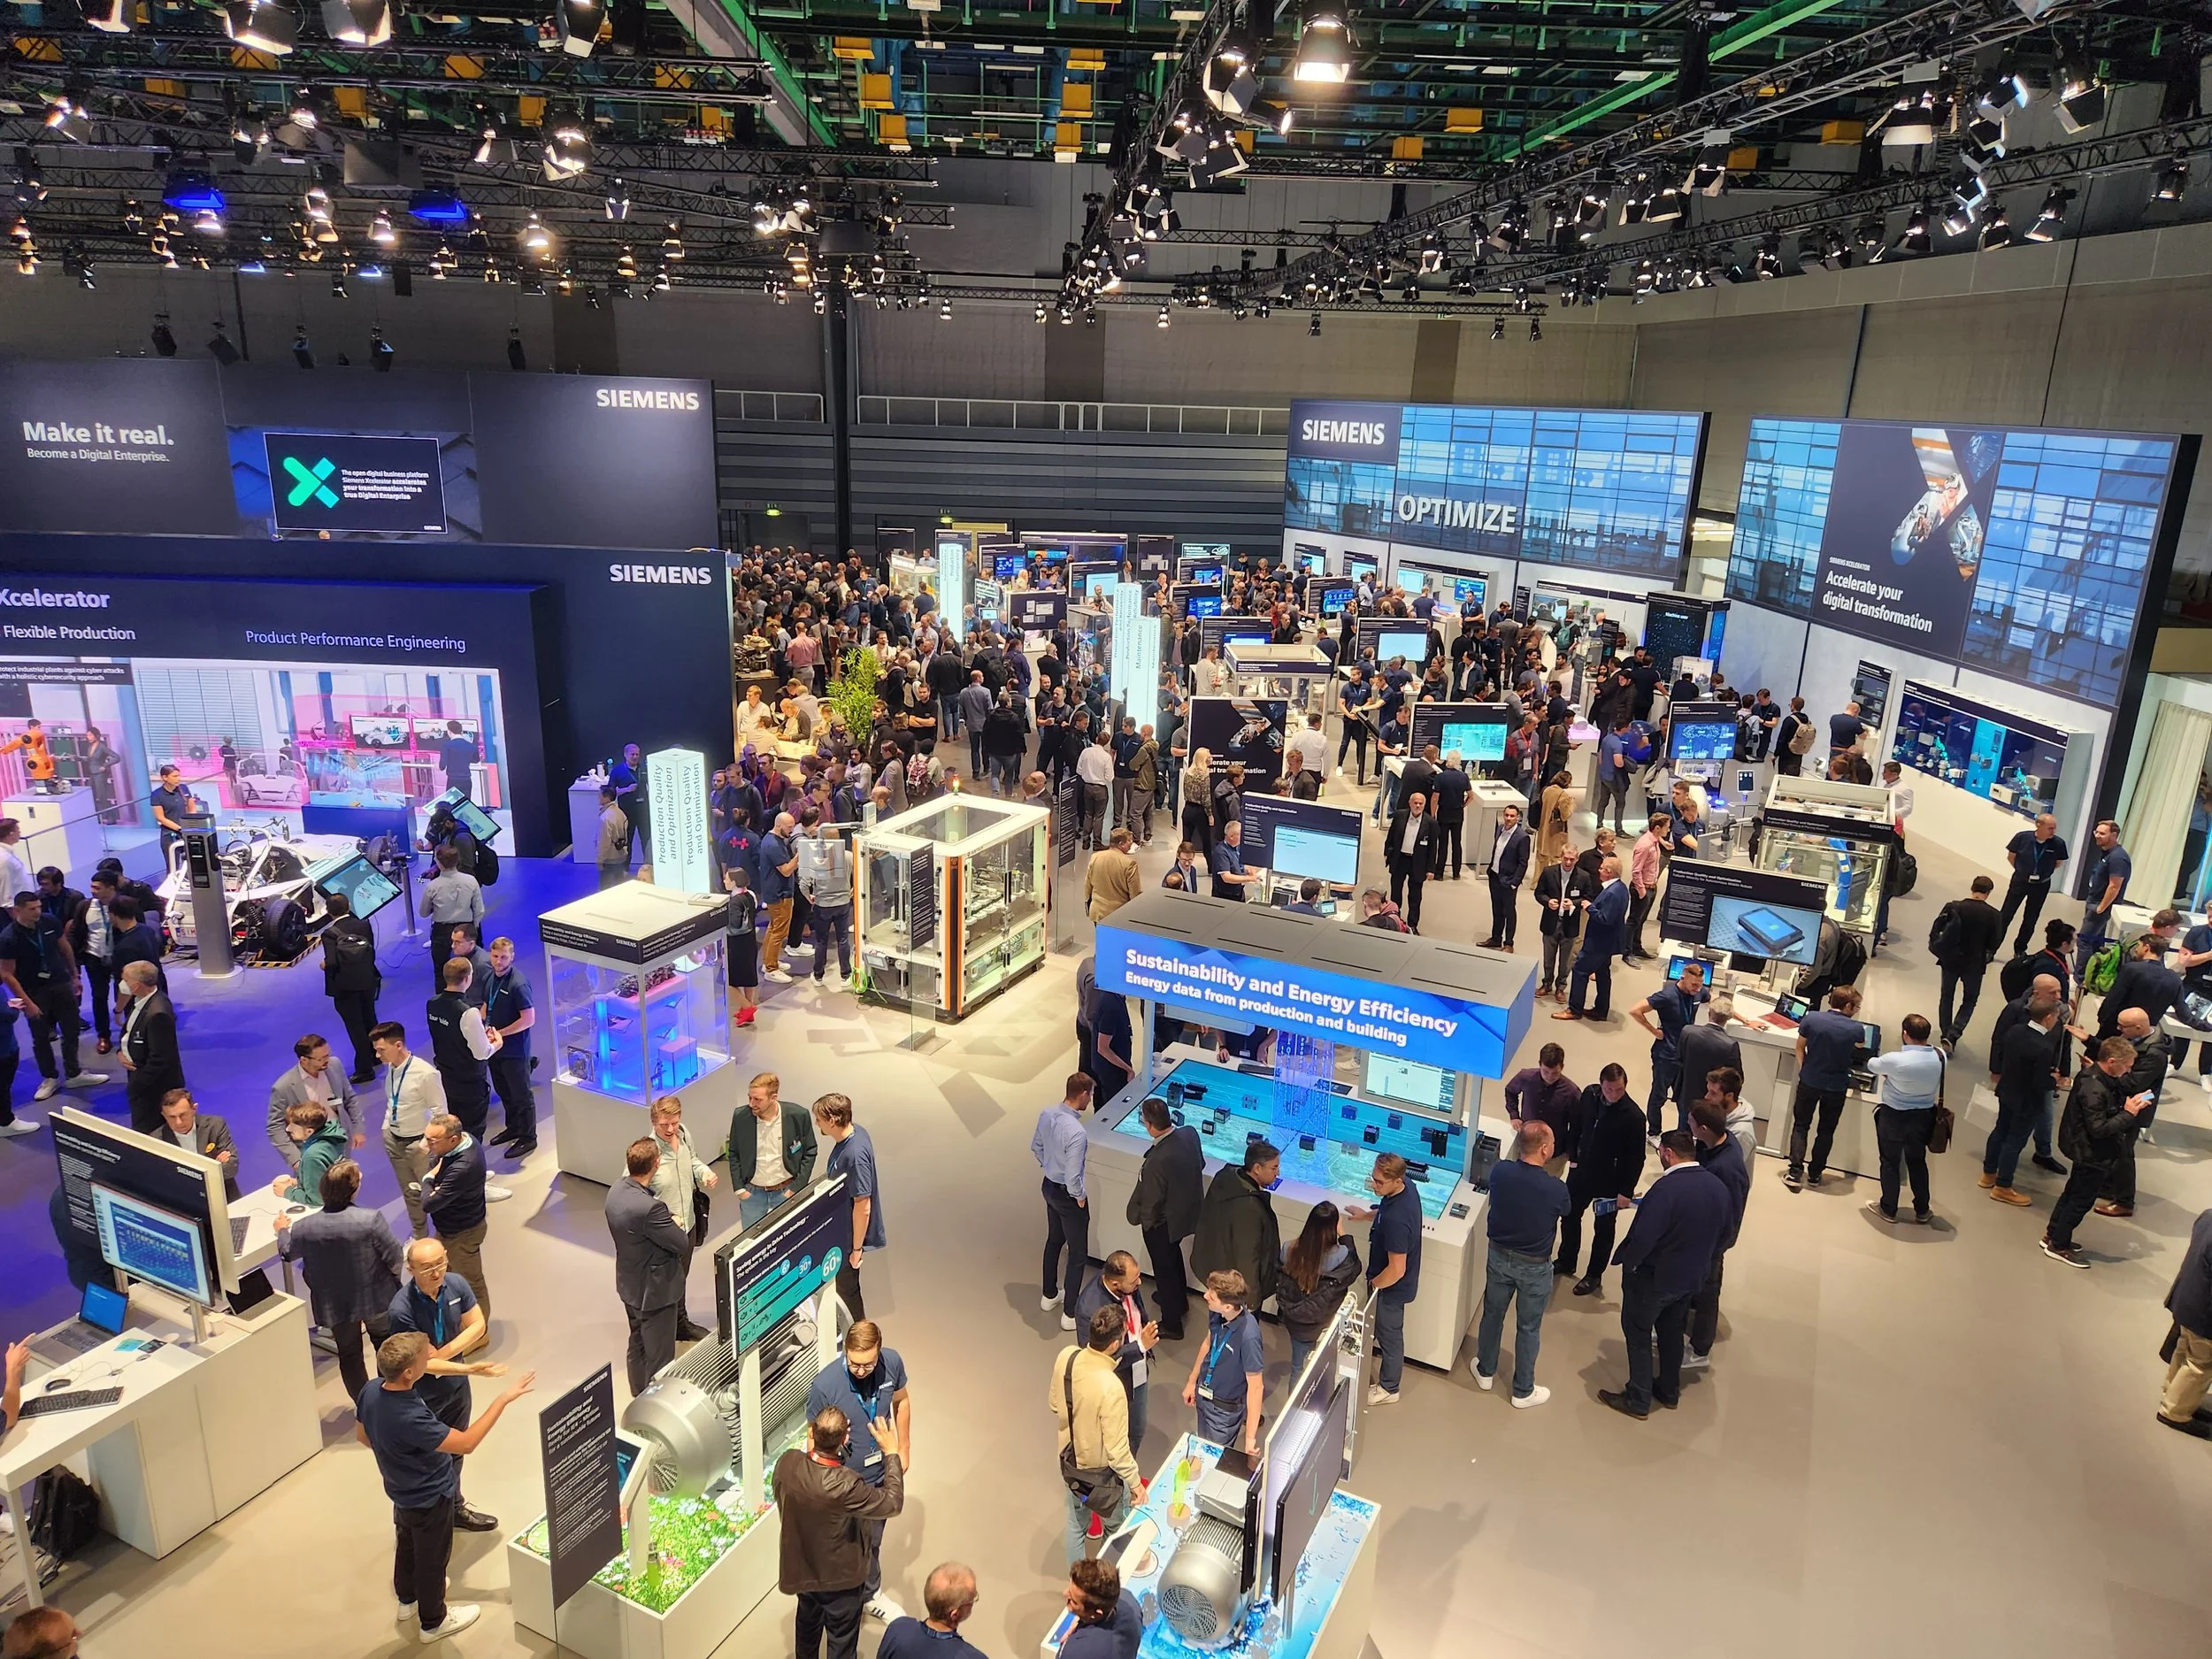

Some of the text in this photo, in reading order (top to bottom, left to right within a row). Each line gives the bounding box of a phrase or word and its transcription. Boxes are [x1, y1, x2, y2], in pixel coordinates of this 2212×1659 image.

[596, 389, 699, 411] SIEMENS
[22, 421, 175, 446] Make it real.
[1302, 419, 1385, 445] SIEMENS
[27, 448, 170, 463] Become a Digital Enterprise.
[1398, 495, 1517, 534] OPTIMIZE
[1829, 557, 1847, 566] SIEMENS
[609, 564, 712, 585] SIEMENS
[1825, 570, 1903, 601] Accelerate your
[0, 588, 111, 608] Xcelerator
[1823, 590, 1932, 633] digital transformation
[4, 626, 136, 640] Flexible Production
[245, 630, 466, 653] Product Performance Engineering
[682, 765, 691, 804] Quality
[666, 767, 676, 836] Optimization
[693, 763, 703, 832] Optimization
[654, 764, 666, 864] Production Quality
[1801, 881, 1825, 890] SIEMENS
[616, 939, 637, 948] SIEMENS
[1125, 949, 1458, 1038] Sustainability and Energy Efficiency
[1125, 971, 1408, 1048] Energy data from production and building
[177, 1166, 203, 1181] SIEMENS
[736, 1260, 752, 1273] Saving
[751, 1248, 767, 1264] energy
[772, 1235, 783, 1248] Drive
[783, 1217, 806, 1237] Technology
[745, 1263, 758, 1274] system
[823, 1256, 841, 1277] 60%
[583, 1371, 608, 1393] SIEMENS
[547, 1395, 593, 1433] Sustainability and
[548, 1405, 591, 1440] Energy Efficiency
